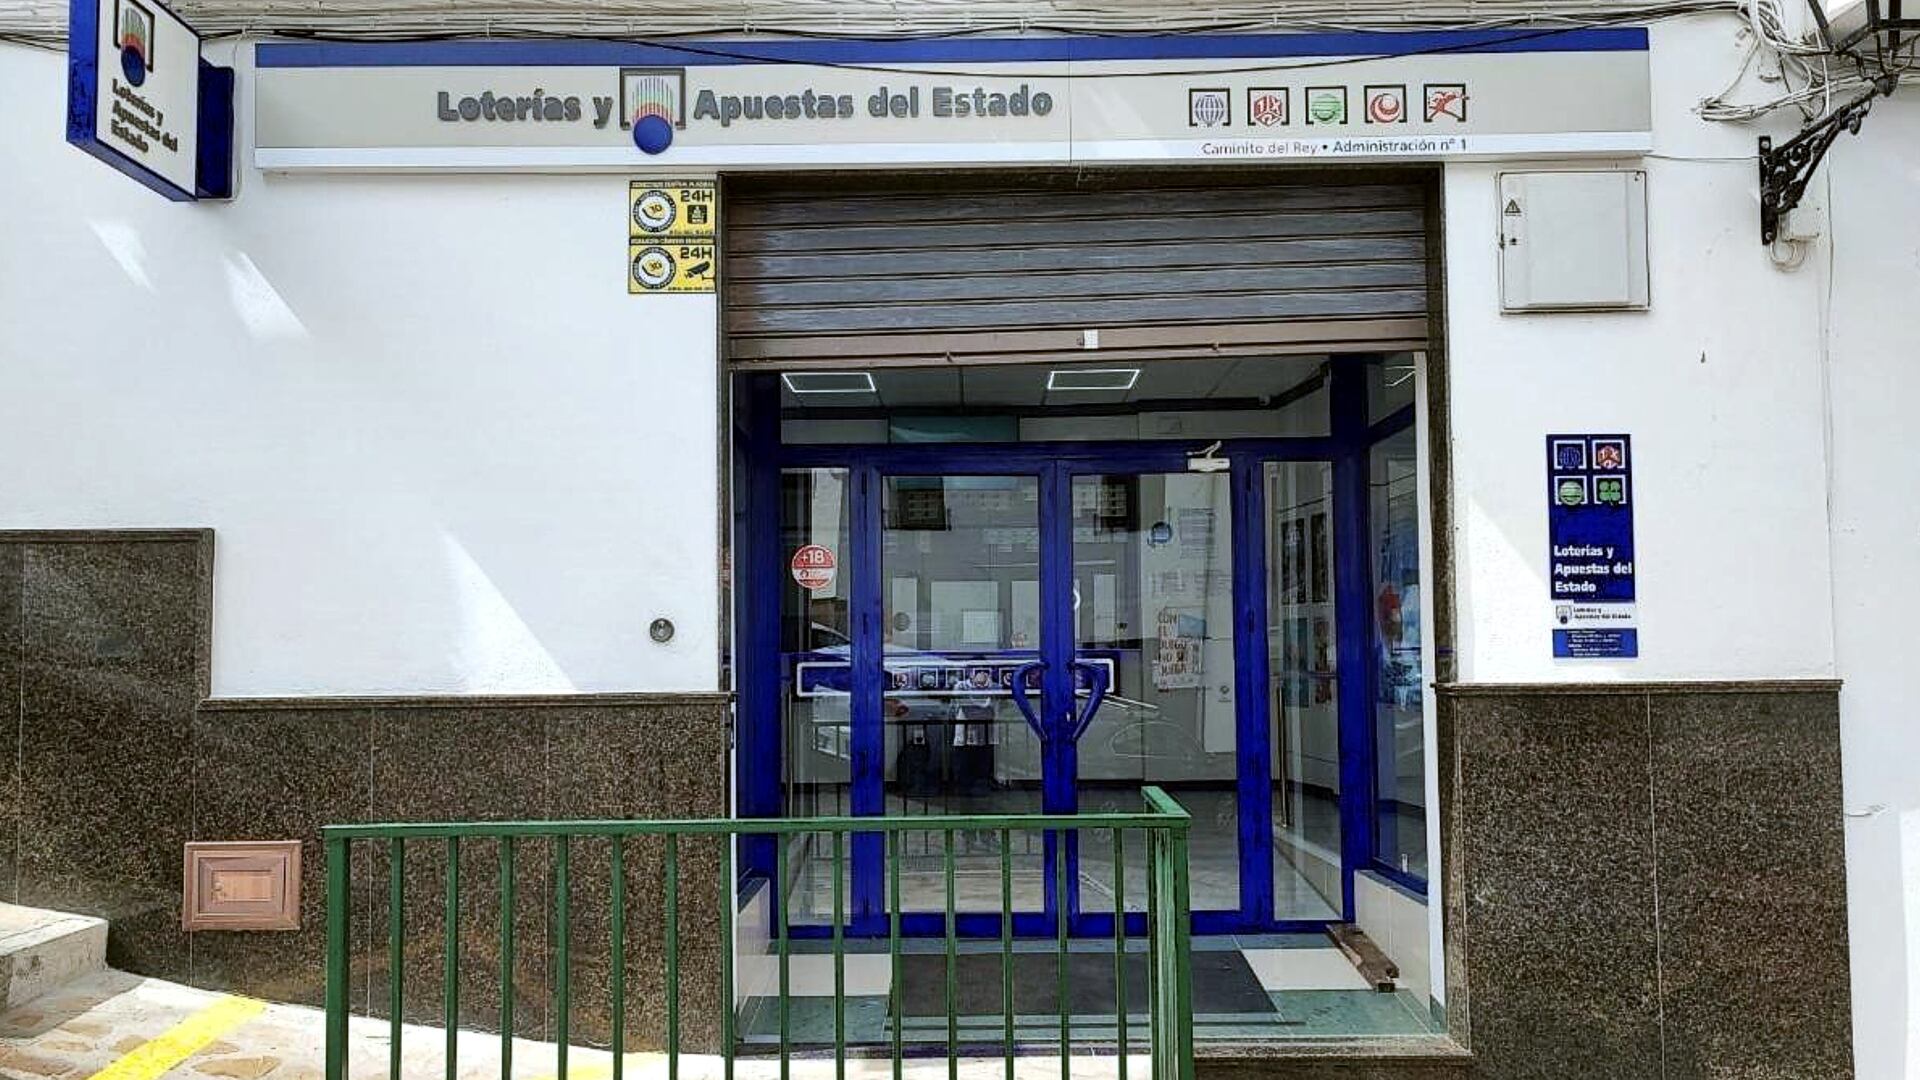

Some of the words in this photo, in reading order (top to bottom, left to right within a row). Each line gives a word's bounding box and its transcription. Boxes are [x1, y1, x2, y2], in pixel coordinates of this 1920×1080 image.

[113, 78, 155, 118] Loterías
[156, 110, 163, 127] y
[437, 87, 582, 122] Loterías
[592, 96, 613, 129] y
[693, 89, 854, 127] Apuestas
[868, 86, 920, 118] del
[932, 84, 1053, 117] Estado
[112, 100, 160, 141] Apuestas
[162, 131, 178, 152] del
[111, 118, 149, 153] Estado
[1201, 143, 1264, 156] Caminito
[1268, 143, 1289, 155] del
[1293, 142, 1317, 157] Rey
[1332, 139, 1435, 154] Administración
[1460, 140, 1468, 152] 1
[680, 190, 713, 202] 24H
[680, 247, 713, 259] 24H
[800, 550, 825, 564] +18
[1553, 545, 1603, 557] Loterías
[1606, 547, 1614, 559] y
[1554, 562, 1610, 577] Apuestas
[1613, 562, 1633, 574] del
[1555, 581, 1597, 593] Estado
